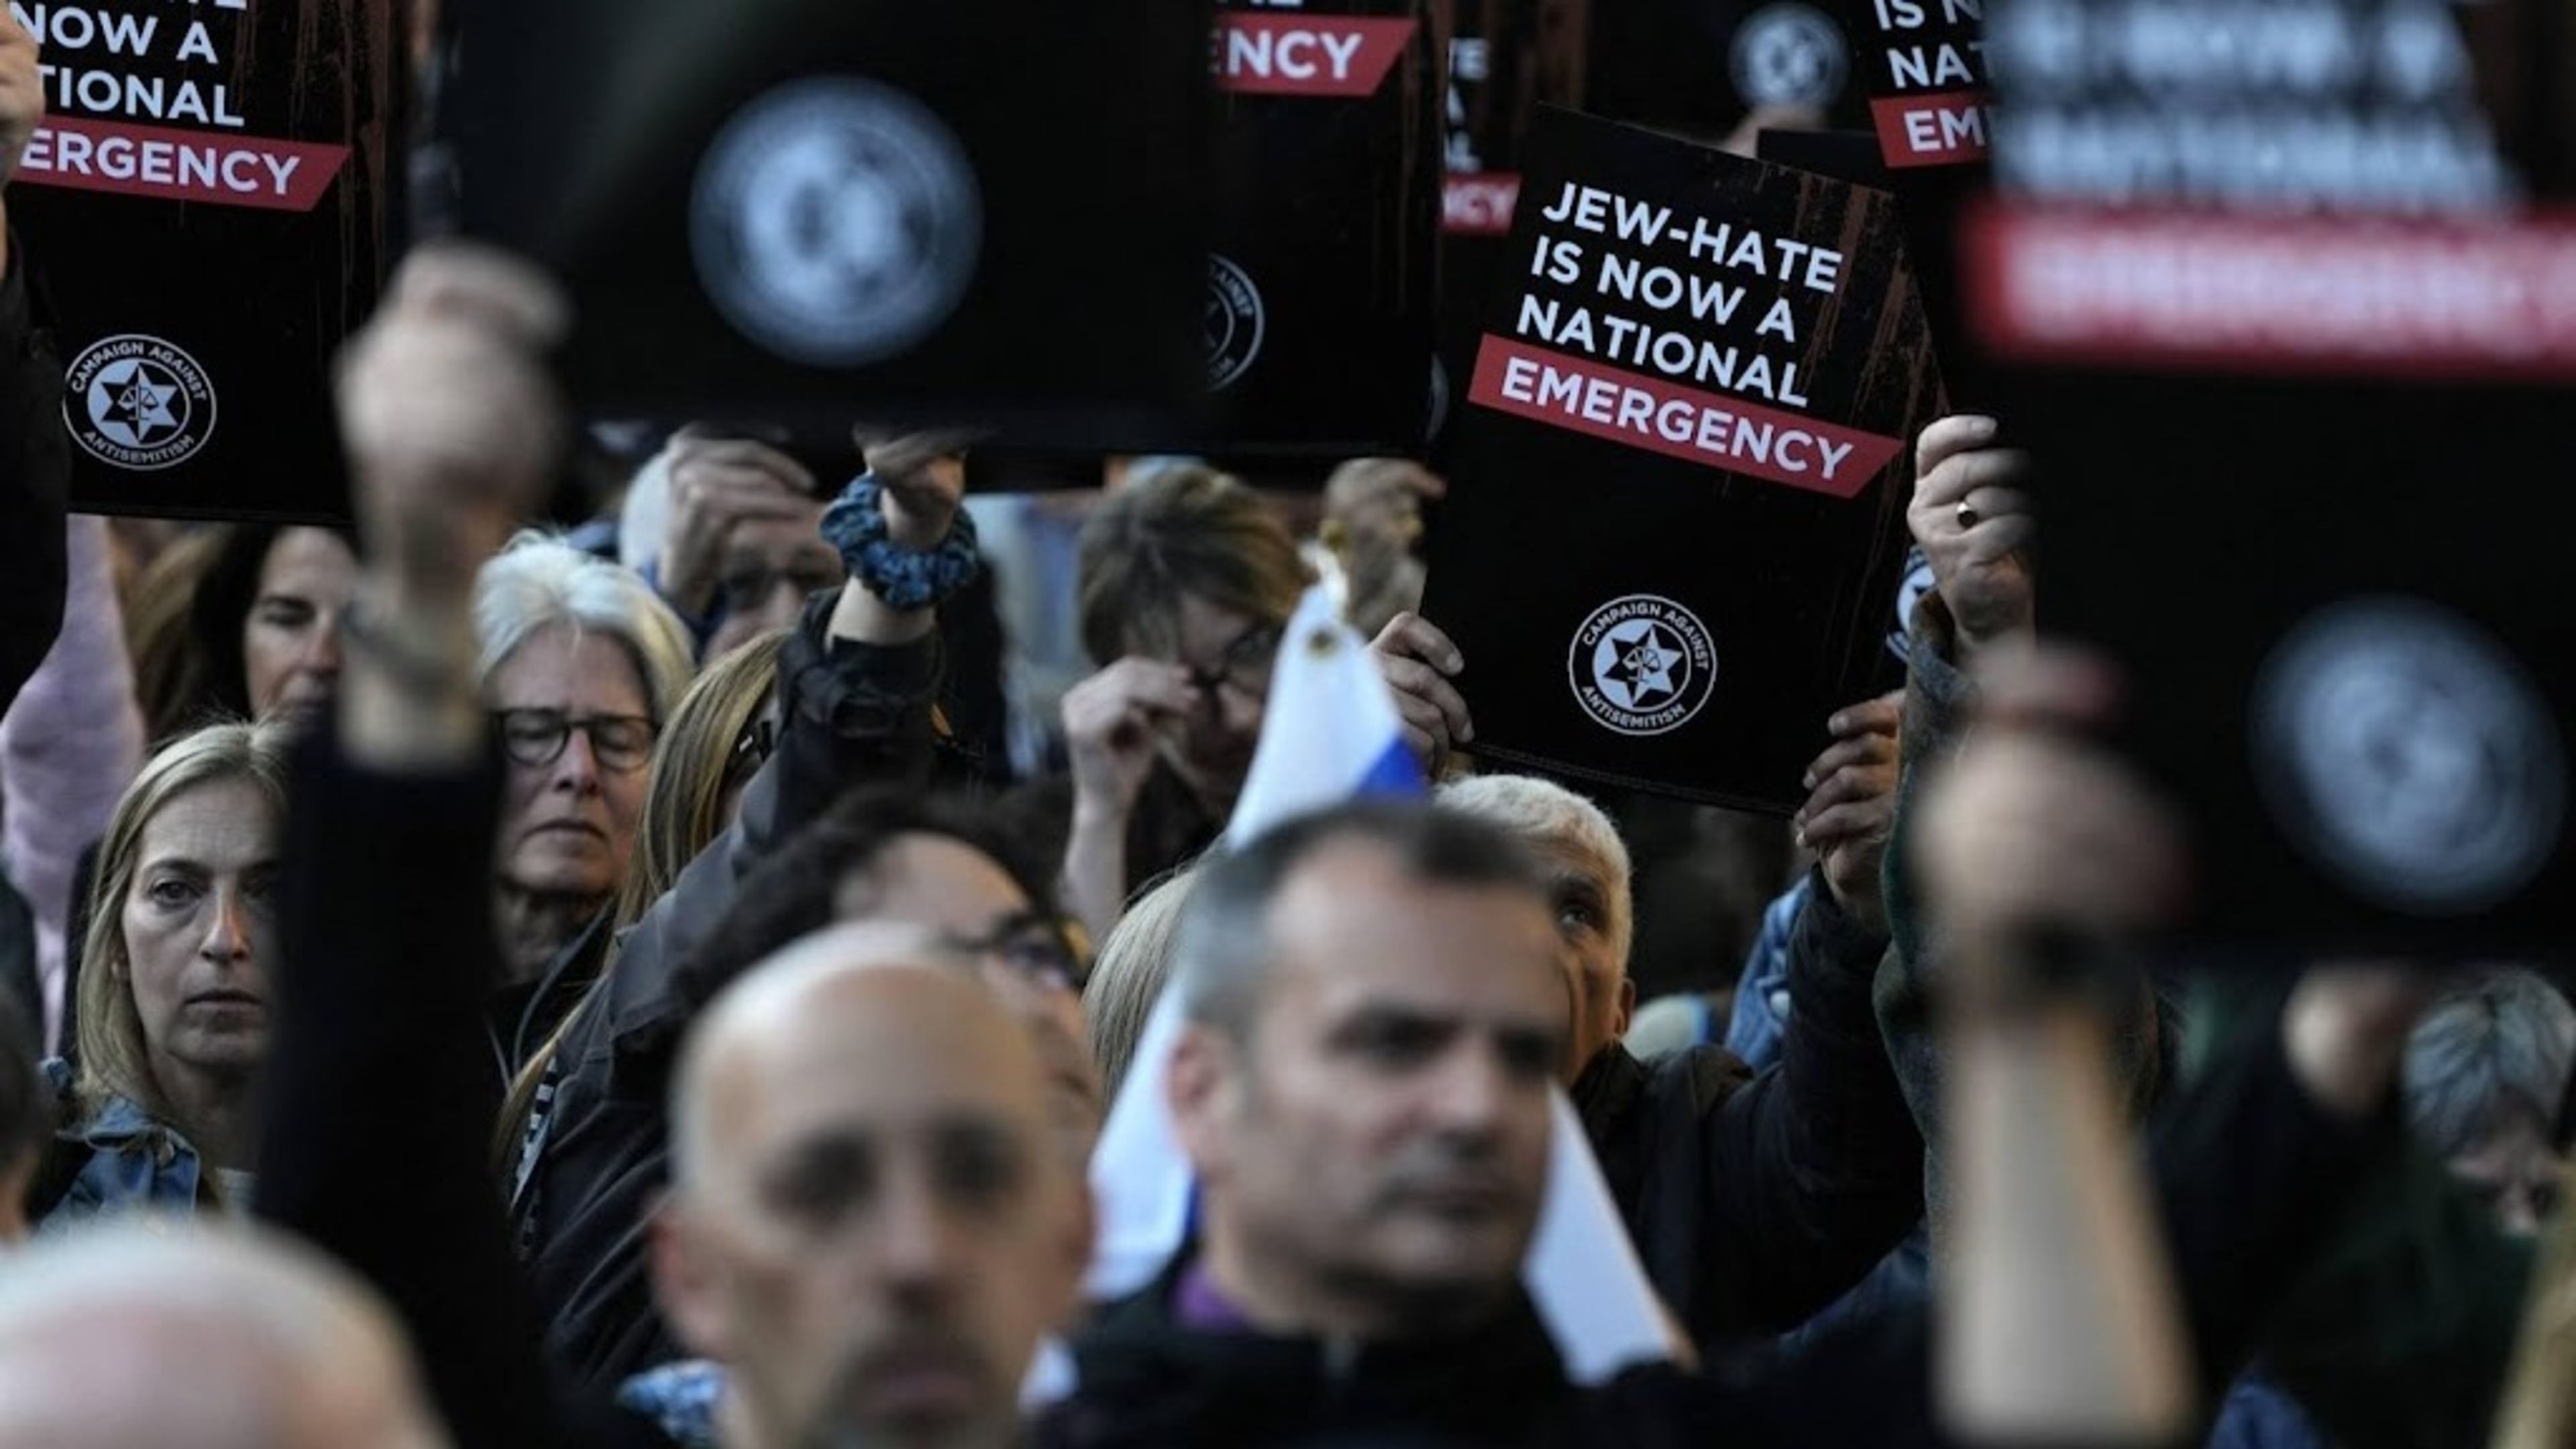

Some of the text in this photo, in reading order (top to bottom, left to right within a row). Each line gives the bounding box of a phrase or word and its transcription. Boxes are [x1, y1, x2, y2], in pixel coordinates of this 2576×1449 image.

[176, 21, 218, 64] A
[1210, 29, 1363, 80] NCY
[37, 64, 244, 126] TIONAL
[1904, 105, 1987, 152] EM
[20, 128, 300, 195] ERGENCY
[1543, 182, 1843, 292] JEW-HATE
[1531, 235, 1795, 343] IS NOW A
[72, 342, 207, 400] CAMPAIGN AGAINST
[1516, 293, 1808, 407] NATIONAL
[83, 431, 195, 464] ANTISEMITISM
[1501, 356, 1854, 480] EMERGENCY
[1582, 602, 1709, 670] CAMPAIGN AGAINST
[1581, 686, 1686, 728] ANTISEMITISM
